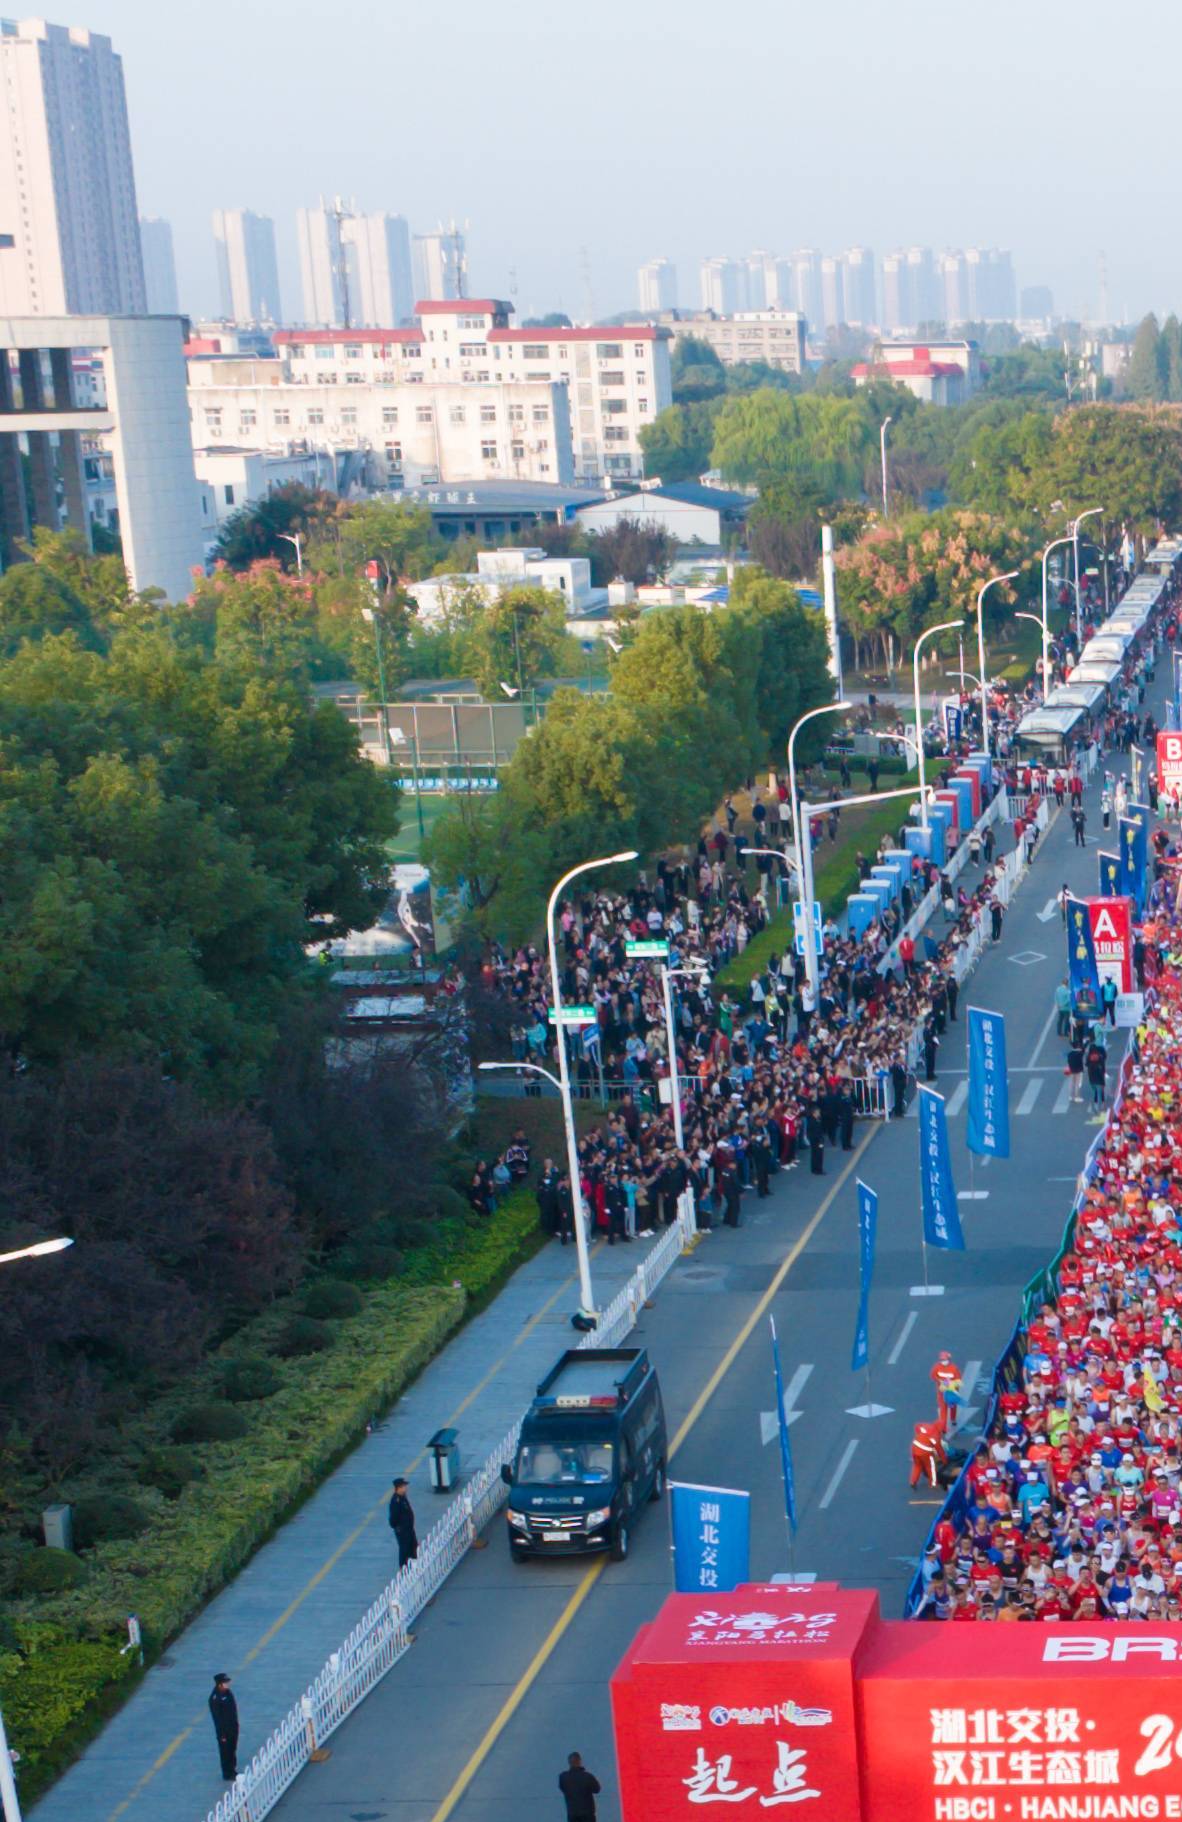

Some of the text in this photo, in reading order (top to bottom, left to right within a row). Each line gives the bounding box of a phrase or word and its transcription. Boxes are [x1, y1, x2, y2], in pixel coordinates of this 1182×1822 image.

[1166, 738, 1182, 760] B
[1094, 908, 1118, 939] A
[699, 1503, 721, 1589] 湖北交投
[682, 1740, 822, 1807] 起点
[932, 1749, 1120, 1786] 汉江生态城
[935, 1795, 996, 1821] HBCI
[1021, 1794, 1160, 1821] HANJIANG
